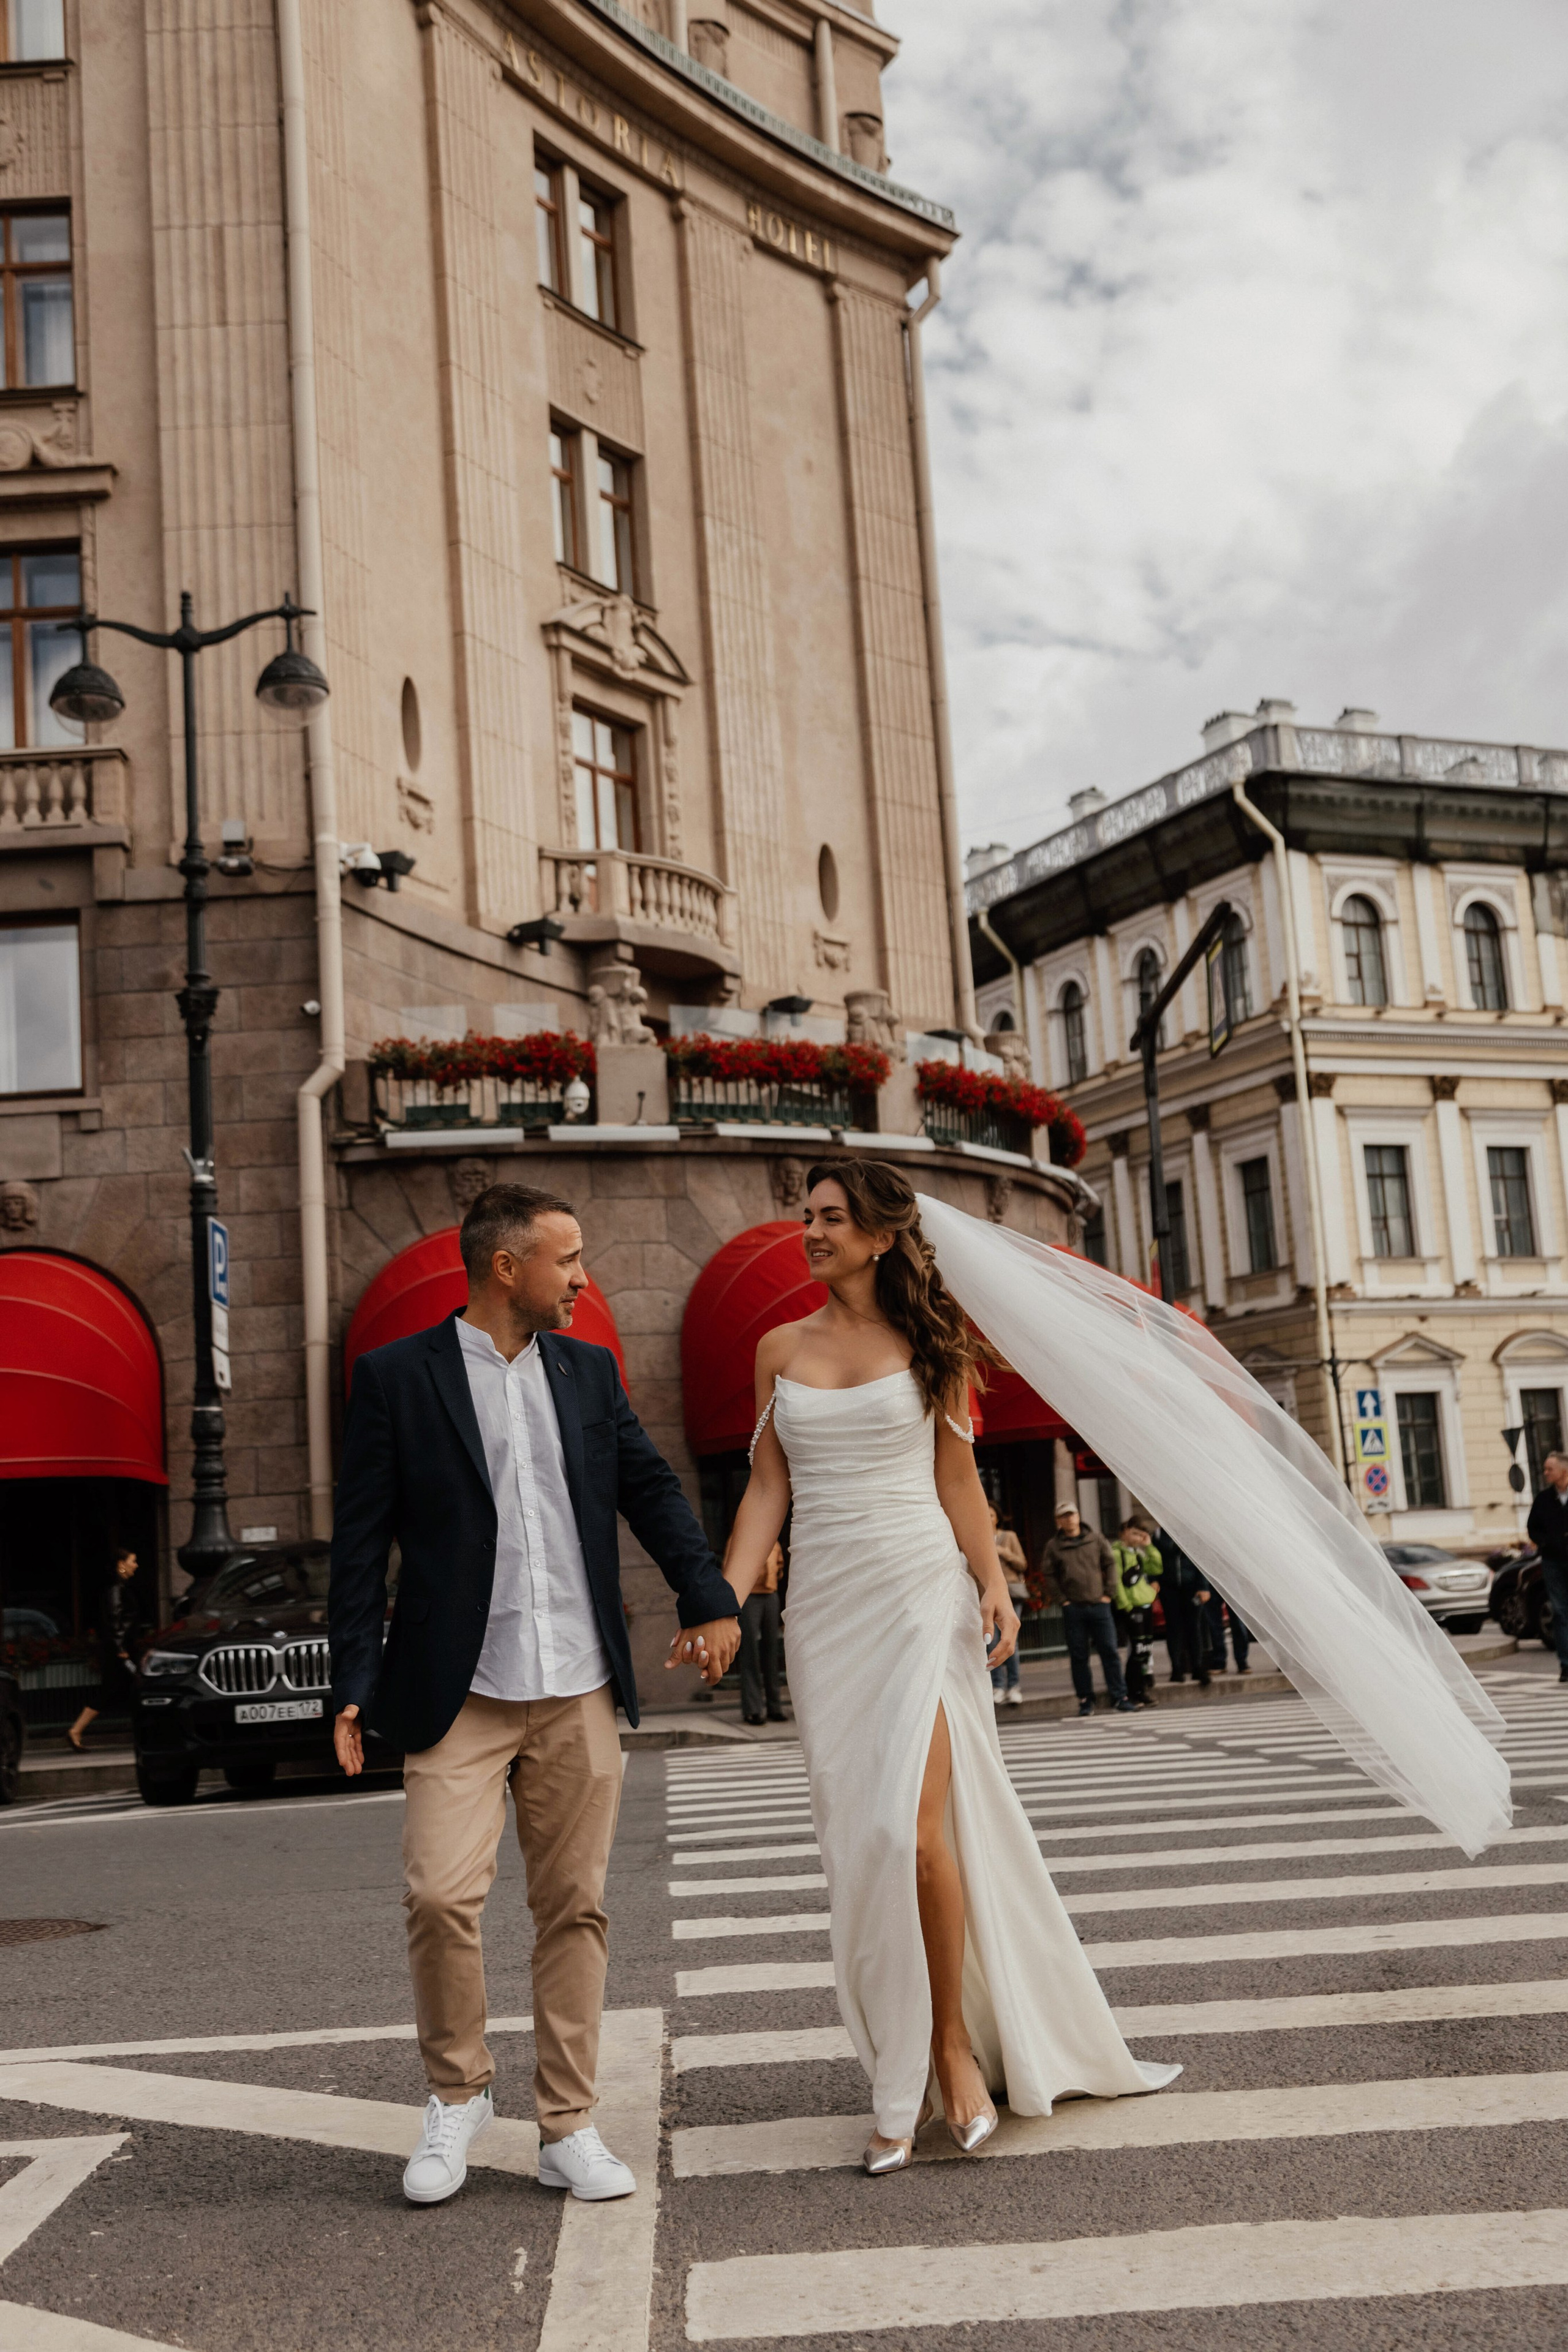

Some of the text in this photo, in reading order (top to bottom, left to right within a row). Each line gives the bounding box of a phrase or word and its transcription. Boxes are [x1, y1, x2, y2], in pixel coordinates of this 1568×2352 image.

[505, 32, 834, 271] ASTORIA HOTEL
[214, 1231, 225, 1293] P
